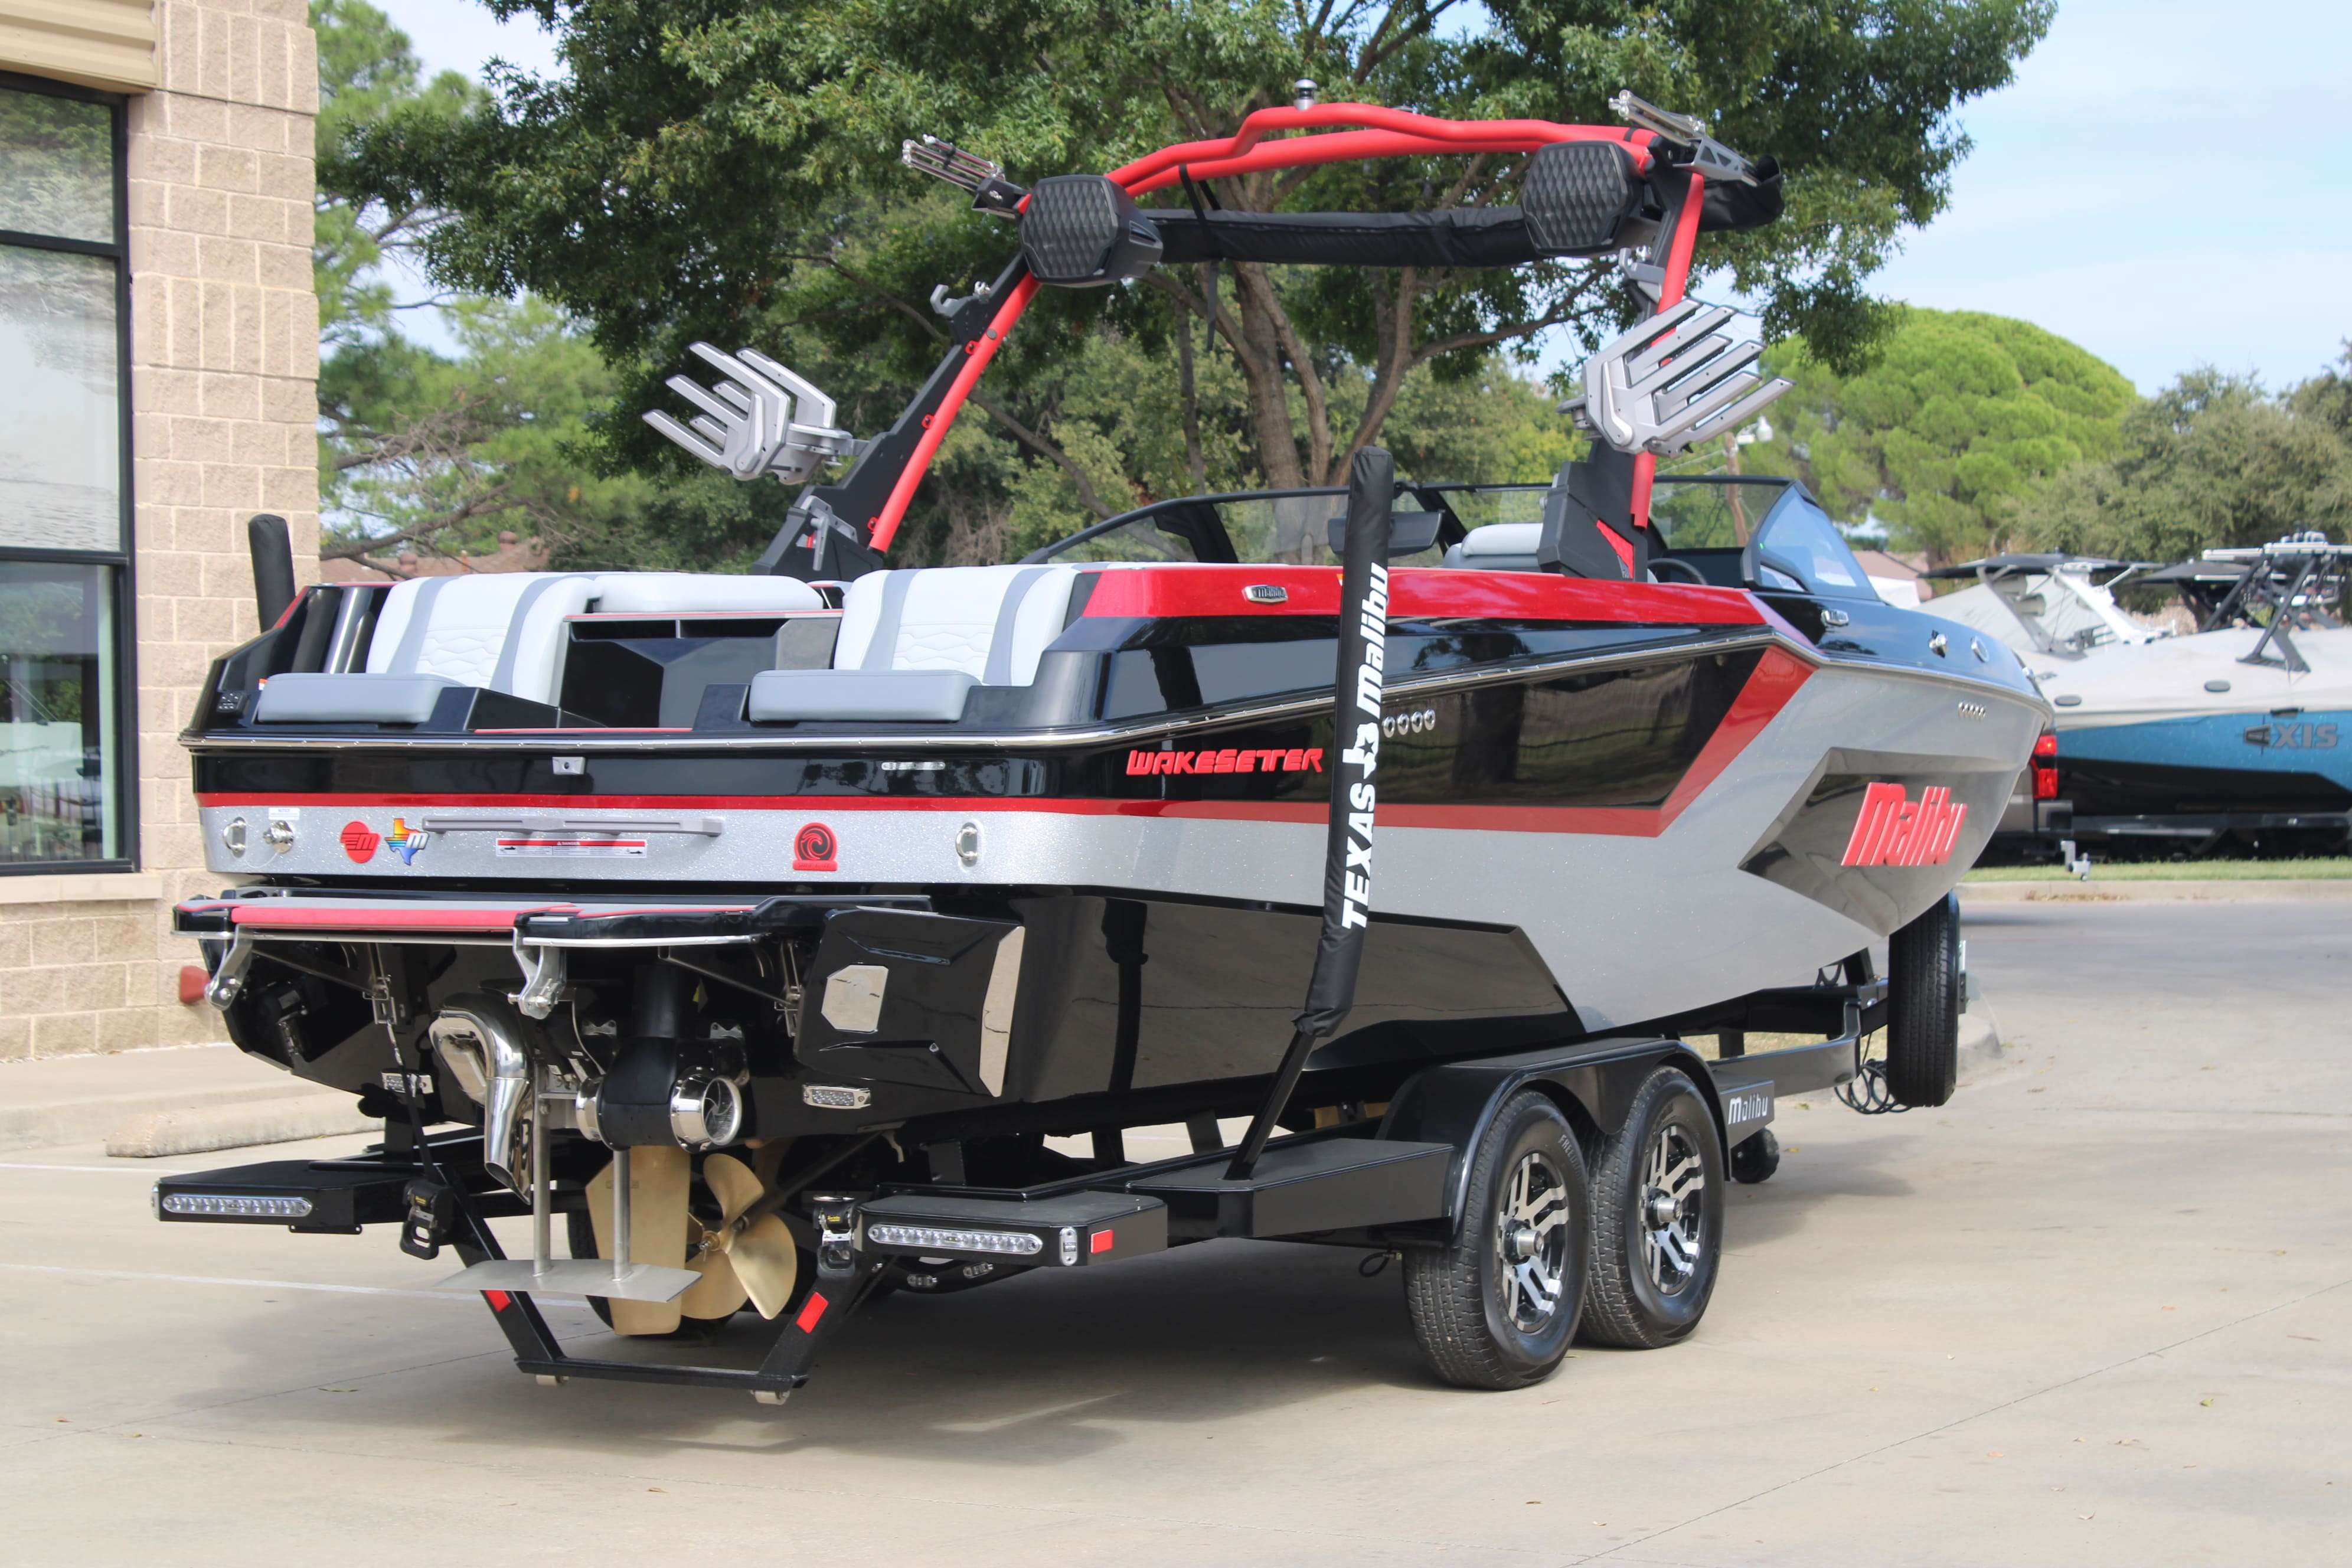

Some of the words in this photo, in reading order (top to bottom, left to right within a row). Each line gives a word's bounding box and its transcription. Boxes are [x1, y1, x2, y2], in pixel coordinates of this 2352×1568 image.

[1357, 562, 1388, 719] Malibu
[1126, 748, 1323, 775] WAKESETTER
[2244, 723, 2338, 748] AXIS
[1841, 782, 1968, 866] Malibu
[1342, 783, 1376, 929] TEXAS
[1728, 1093, 1768, 1125] Malibu
